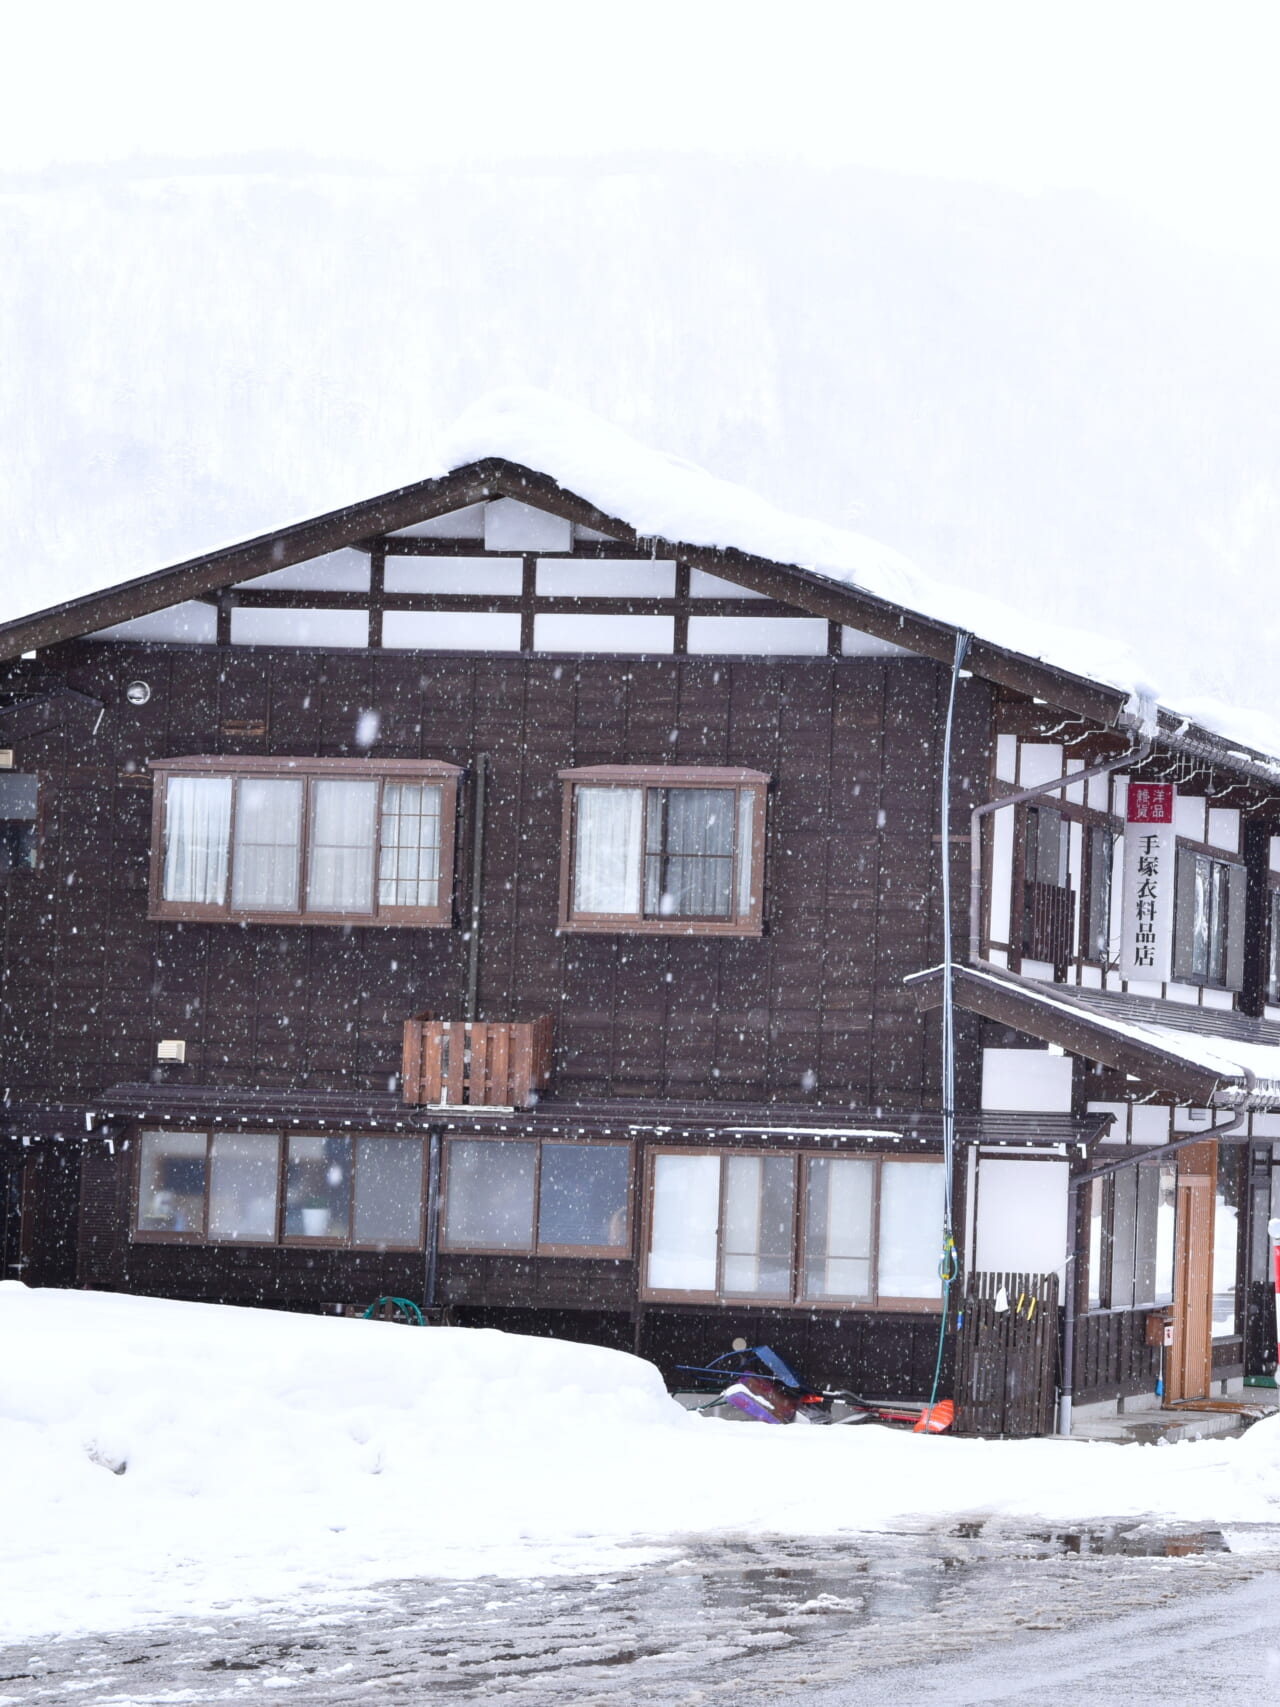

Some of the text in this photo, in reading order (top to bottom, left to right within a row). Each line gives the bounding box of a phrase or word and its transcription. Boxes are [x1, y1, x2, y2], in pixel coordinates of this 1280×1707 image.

[1148, 789, 1165, 818] 洋品
[1134, 835, 1160, 966] 手塚衣料品店
